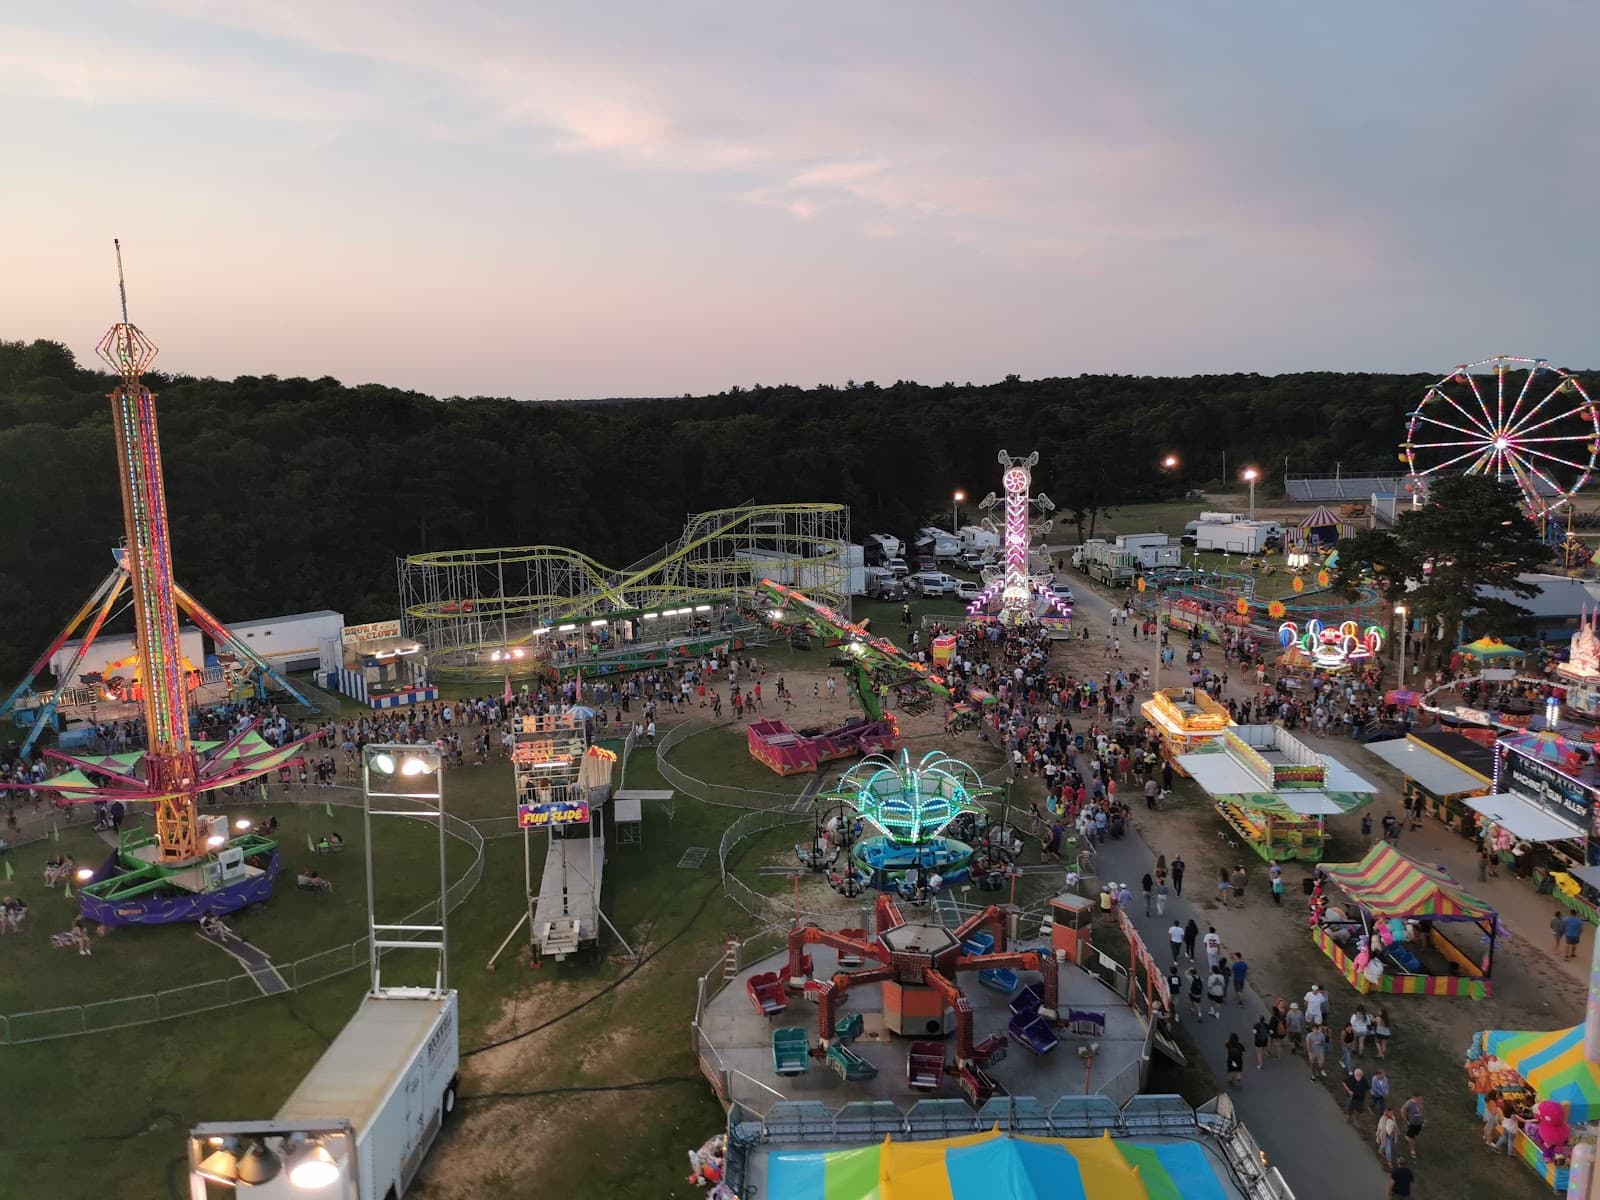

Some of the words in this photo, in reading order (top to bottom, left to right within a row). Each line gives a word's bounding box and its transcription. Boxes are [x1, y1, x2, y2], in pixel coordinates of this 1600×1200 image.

[366, 628, 398, 639] CLOWN
[1563, 799, 1587, 816] ALLEY
[523, 812, 549, 825] FUN
[550, 809, 583, 822] SLIDE
